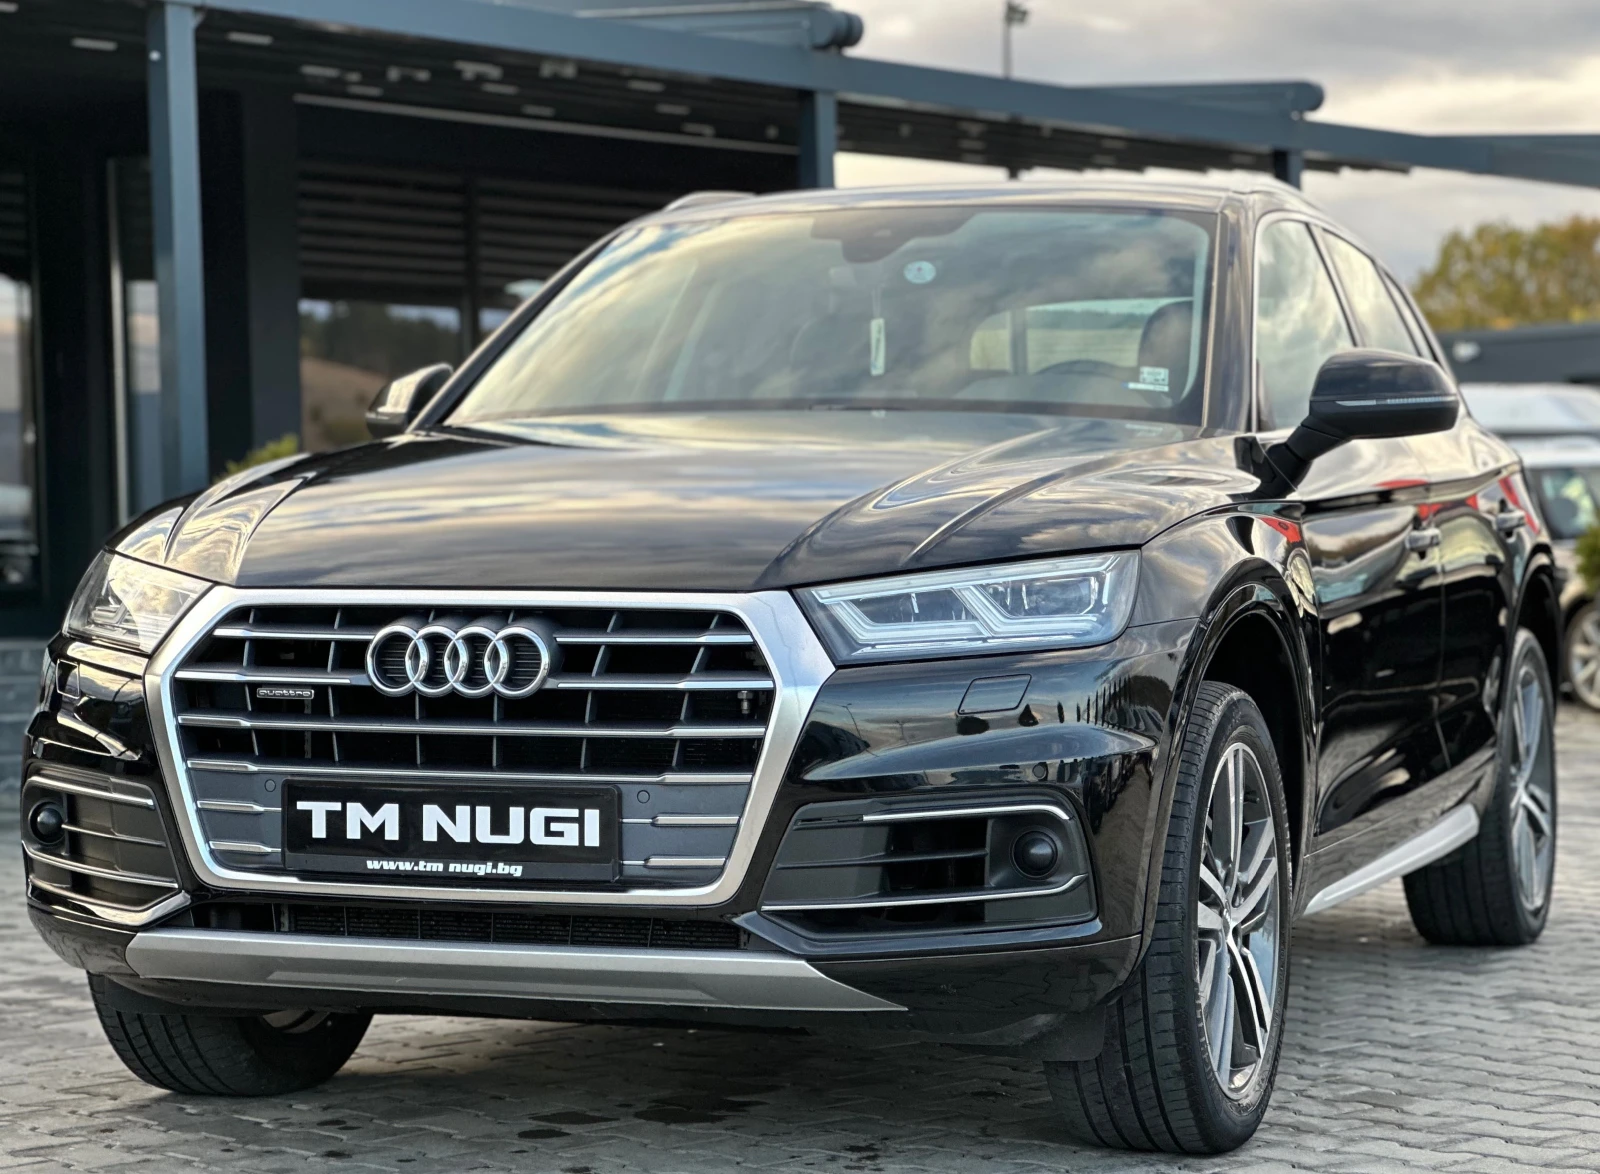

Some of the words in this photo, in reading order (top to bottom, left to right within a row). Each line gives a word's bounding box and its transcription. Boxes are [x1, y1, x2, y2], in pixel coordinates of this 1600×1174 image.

[296, 801, 400, 841] TM
[422, 804, 600, 847] NUGI
[366, 860, 444, 872] www.tm
[448, 862, 523, 877] nugi.bg
